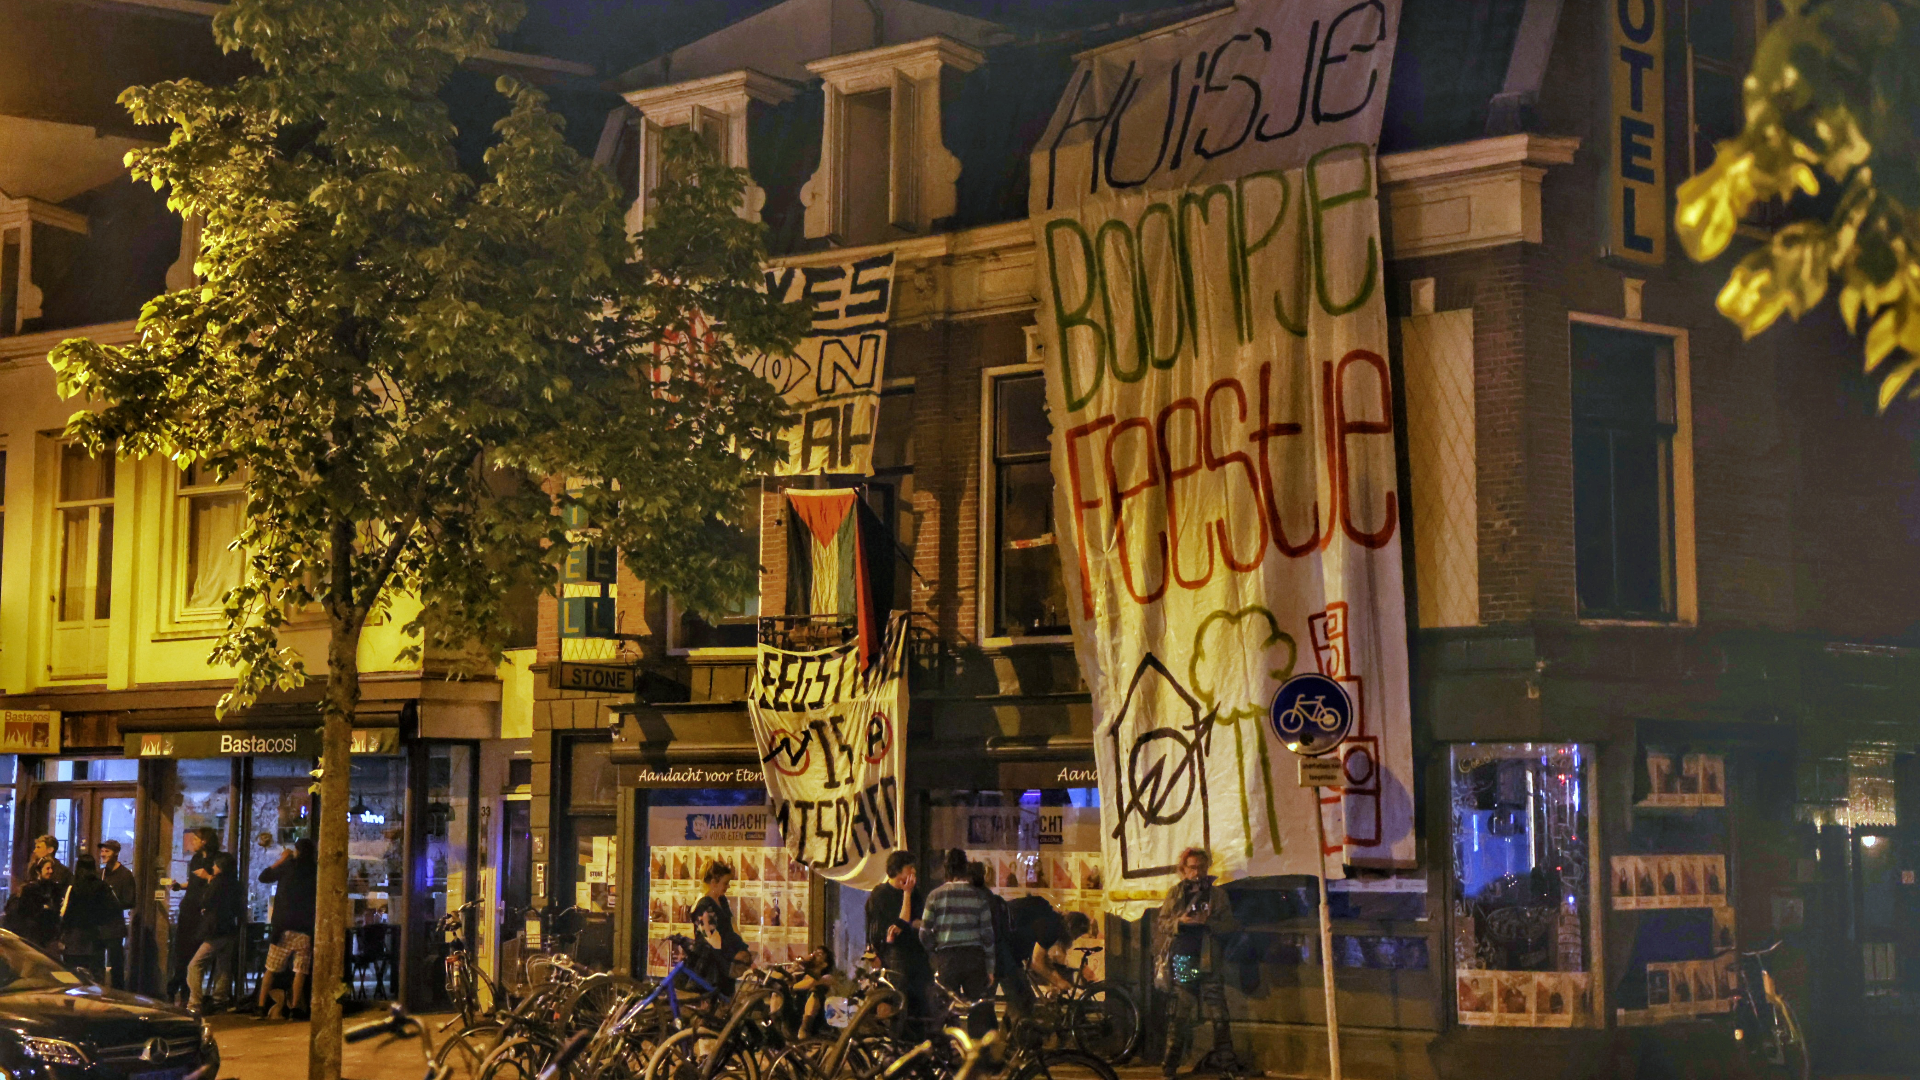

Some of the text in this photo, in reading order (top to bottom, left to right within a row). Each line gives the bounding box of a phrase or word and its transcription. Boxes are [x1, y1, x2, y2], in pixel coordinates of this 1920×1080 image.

[572, 668, 626, 689] STONE
[220, 734, 297, 753] Bastacosi
[639, 767, 766, 782] Aandacht voor Eten
[480, 806, 491, 817] 33
[709, 813, 768, 830] AANDACHT
